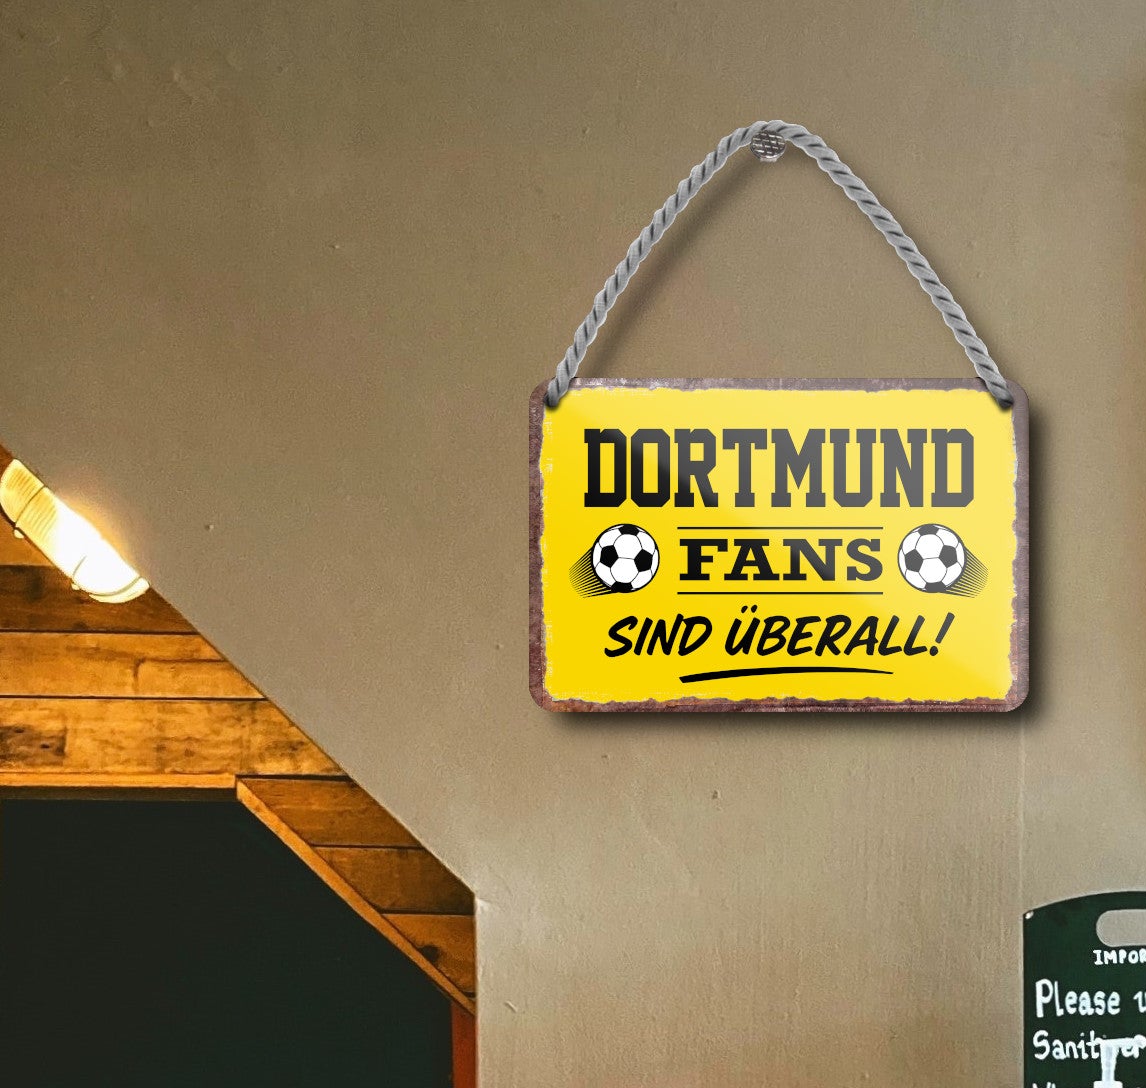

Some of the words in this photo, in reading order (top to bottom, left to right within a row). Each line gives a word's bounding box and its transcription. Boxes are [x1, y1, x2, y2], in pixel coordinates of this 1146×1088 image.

[583, 428, 975, 508] DORTMUND
[679, 538, 883, 582] FANS
[604, 615, 713, 658] SIND
[725, 604, 956, 657] ÜBERALL!
[1035, 979, 1121, 1018] Please
